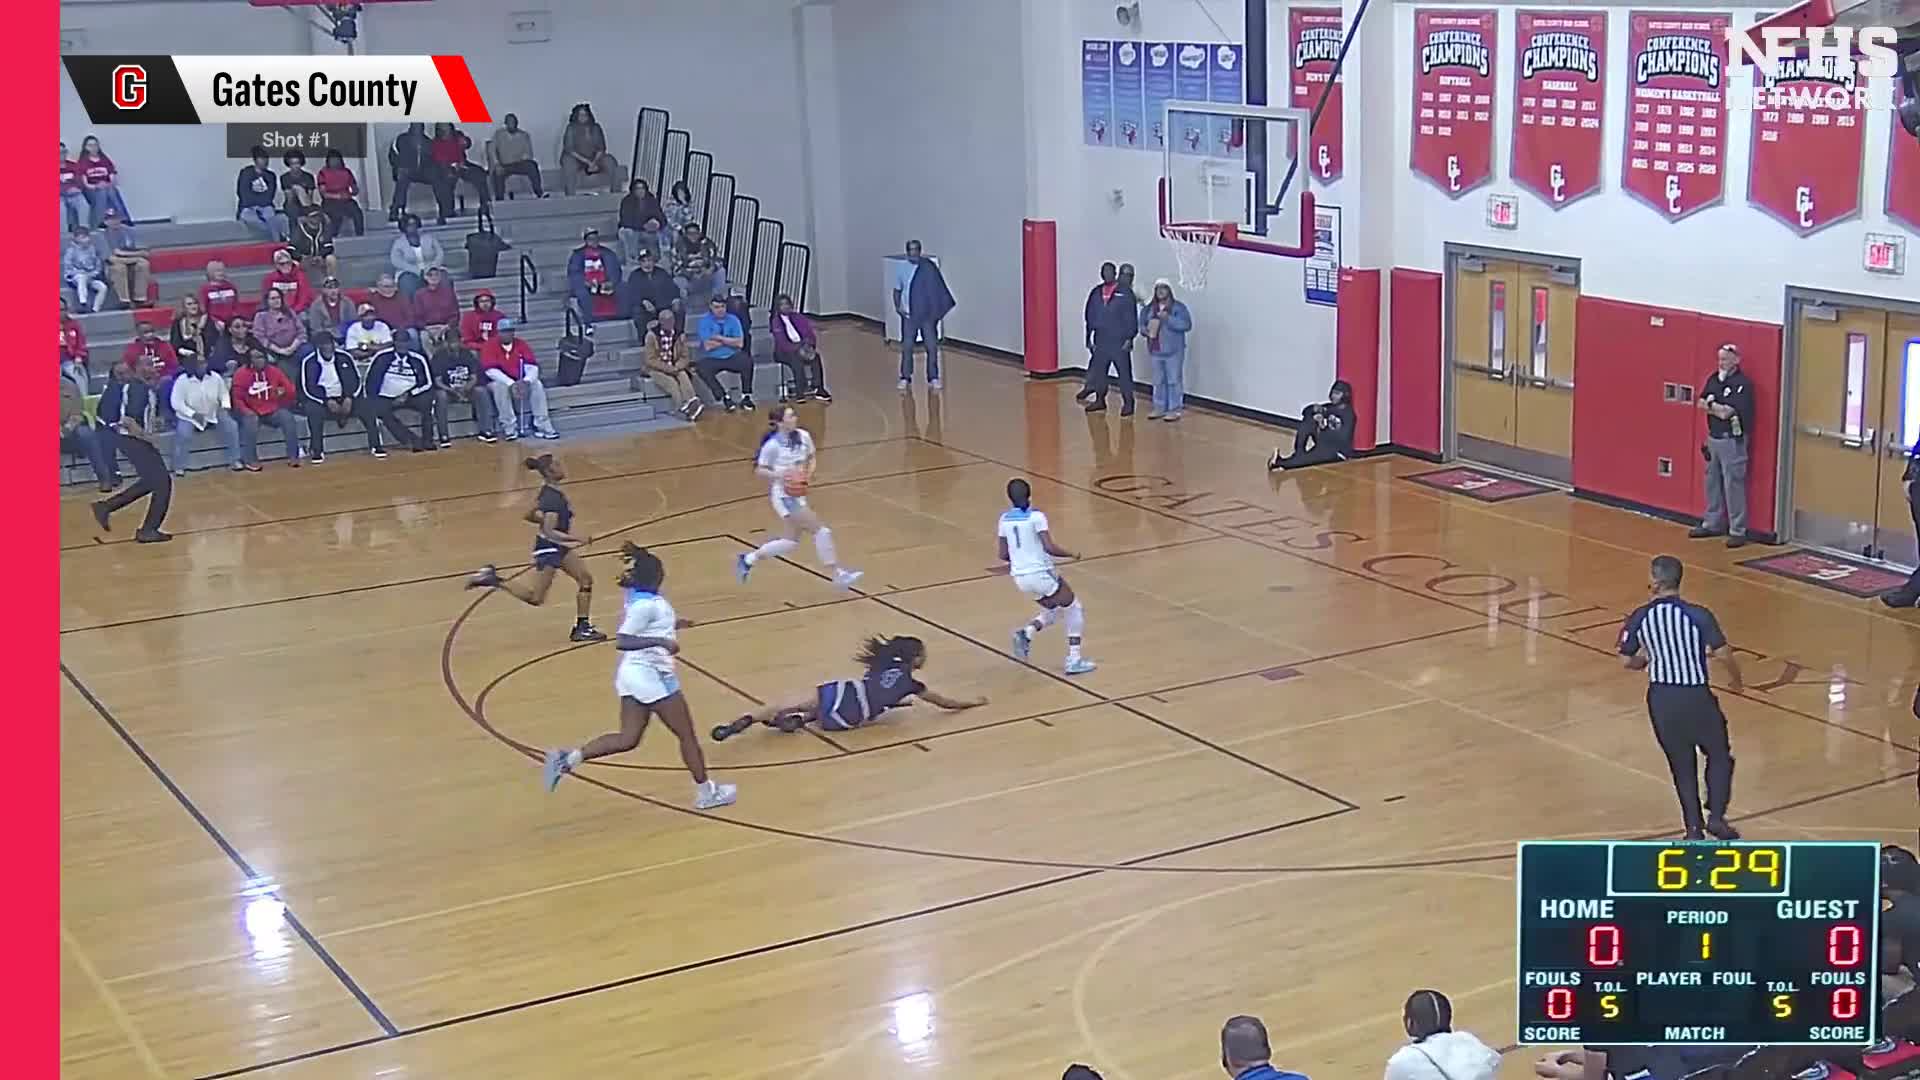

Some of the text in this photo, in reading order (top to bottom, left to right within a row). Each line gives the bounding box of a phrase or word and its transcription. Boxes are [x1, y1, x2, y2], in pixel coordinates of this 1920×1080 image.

[1429, 31, 1481, 46] CONFERENCE
[1531, 33, 1589, 50] CONFERENCE
[1647, 36, 1711, 53] CONFERENCE
[1422, 43, 1488, 75] CHAMPIONS
[1523, 47, 1596, 80] CHAMPIONS
[1637, 50, 1719, 87] CHAMPIONS
[1094, 475, 1373, 550] GATES
[1013, 524, 1021, 549] 1
